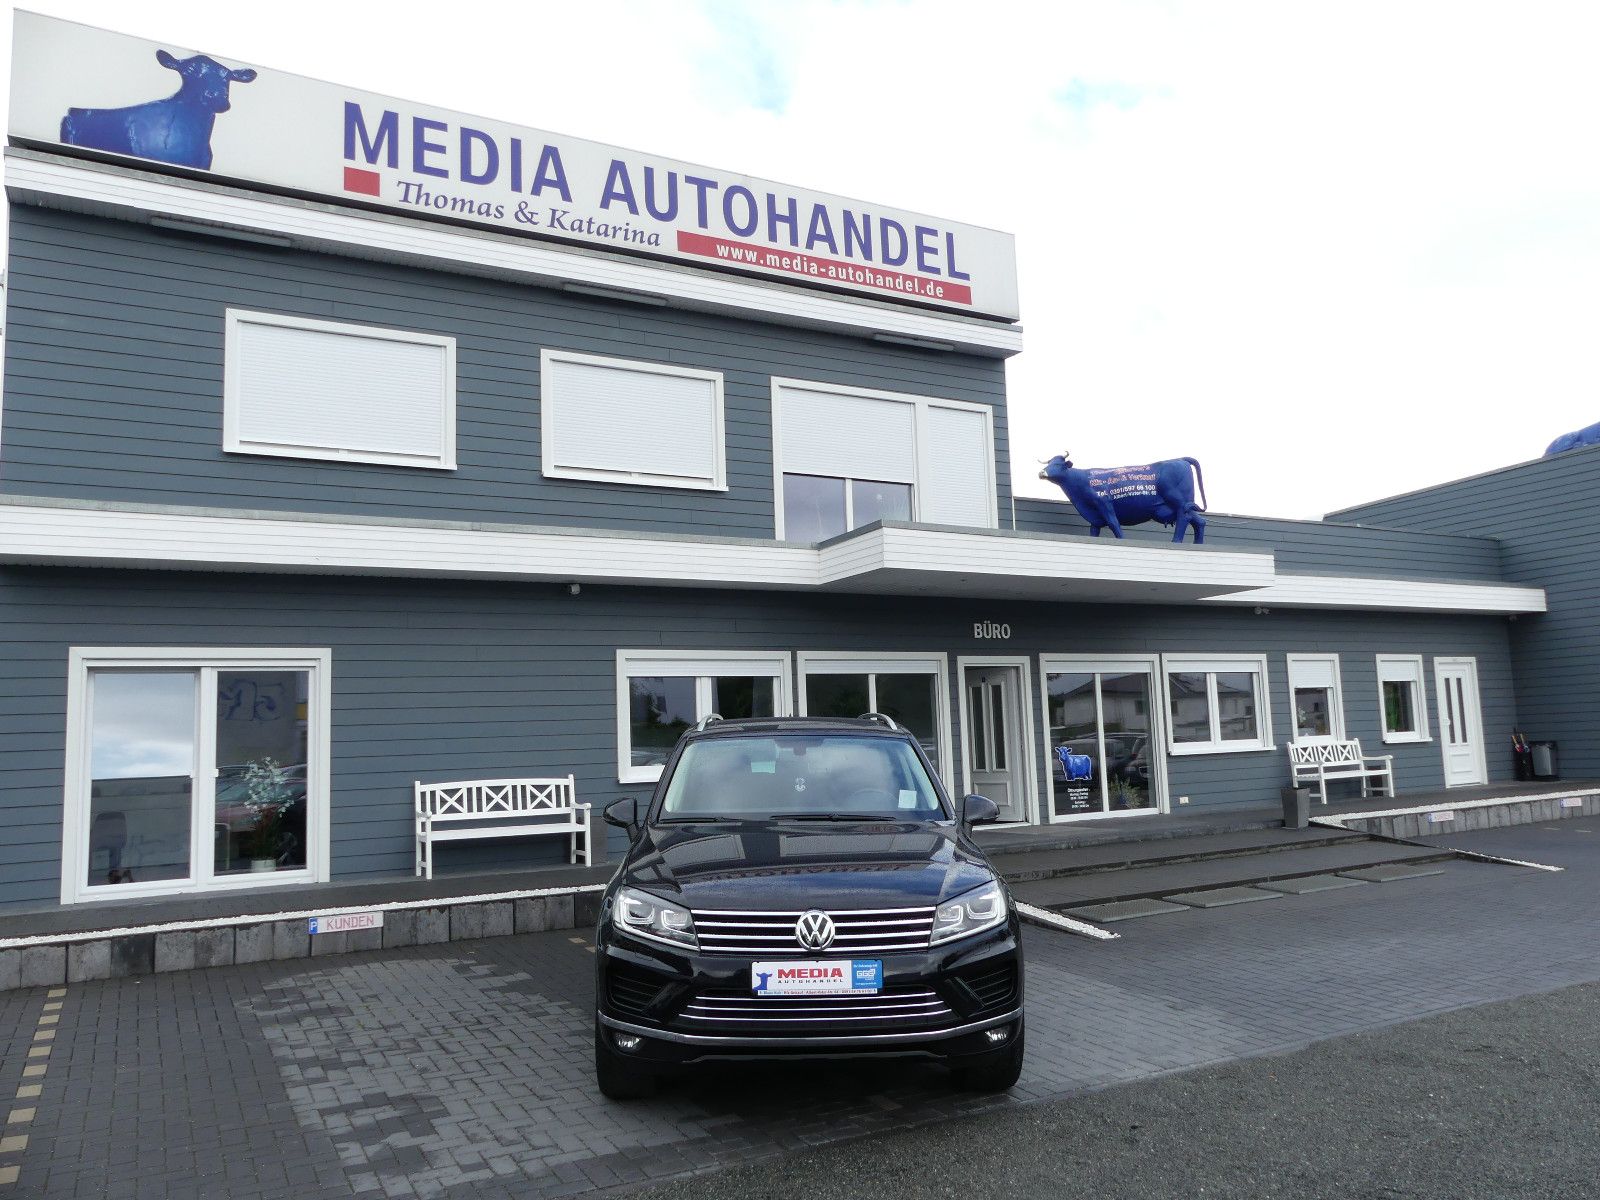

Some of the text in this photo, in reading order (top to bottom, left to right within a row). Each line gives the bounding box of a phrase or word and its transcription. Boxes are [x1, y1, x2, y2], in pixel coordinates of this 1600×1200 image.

[344, 101, 971, 281] MEDIA AUTOHANDEL
[396, 180, 661, 247] Thomas & Katarina
[716, 242, 944, 299] www.media-autohandel.de
[973, 620, 1011, 639] BÜRO
[310, 914, 374, 931] P KUNDEN
[777, 968, 843, 979] MEDIA
